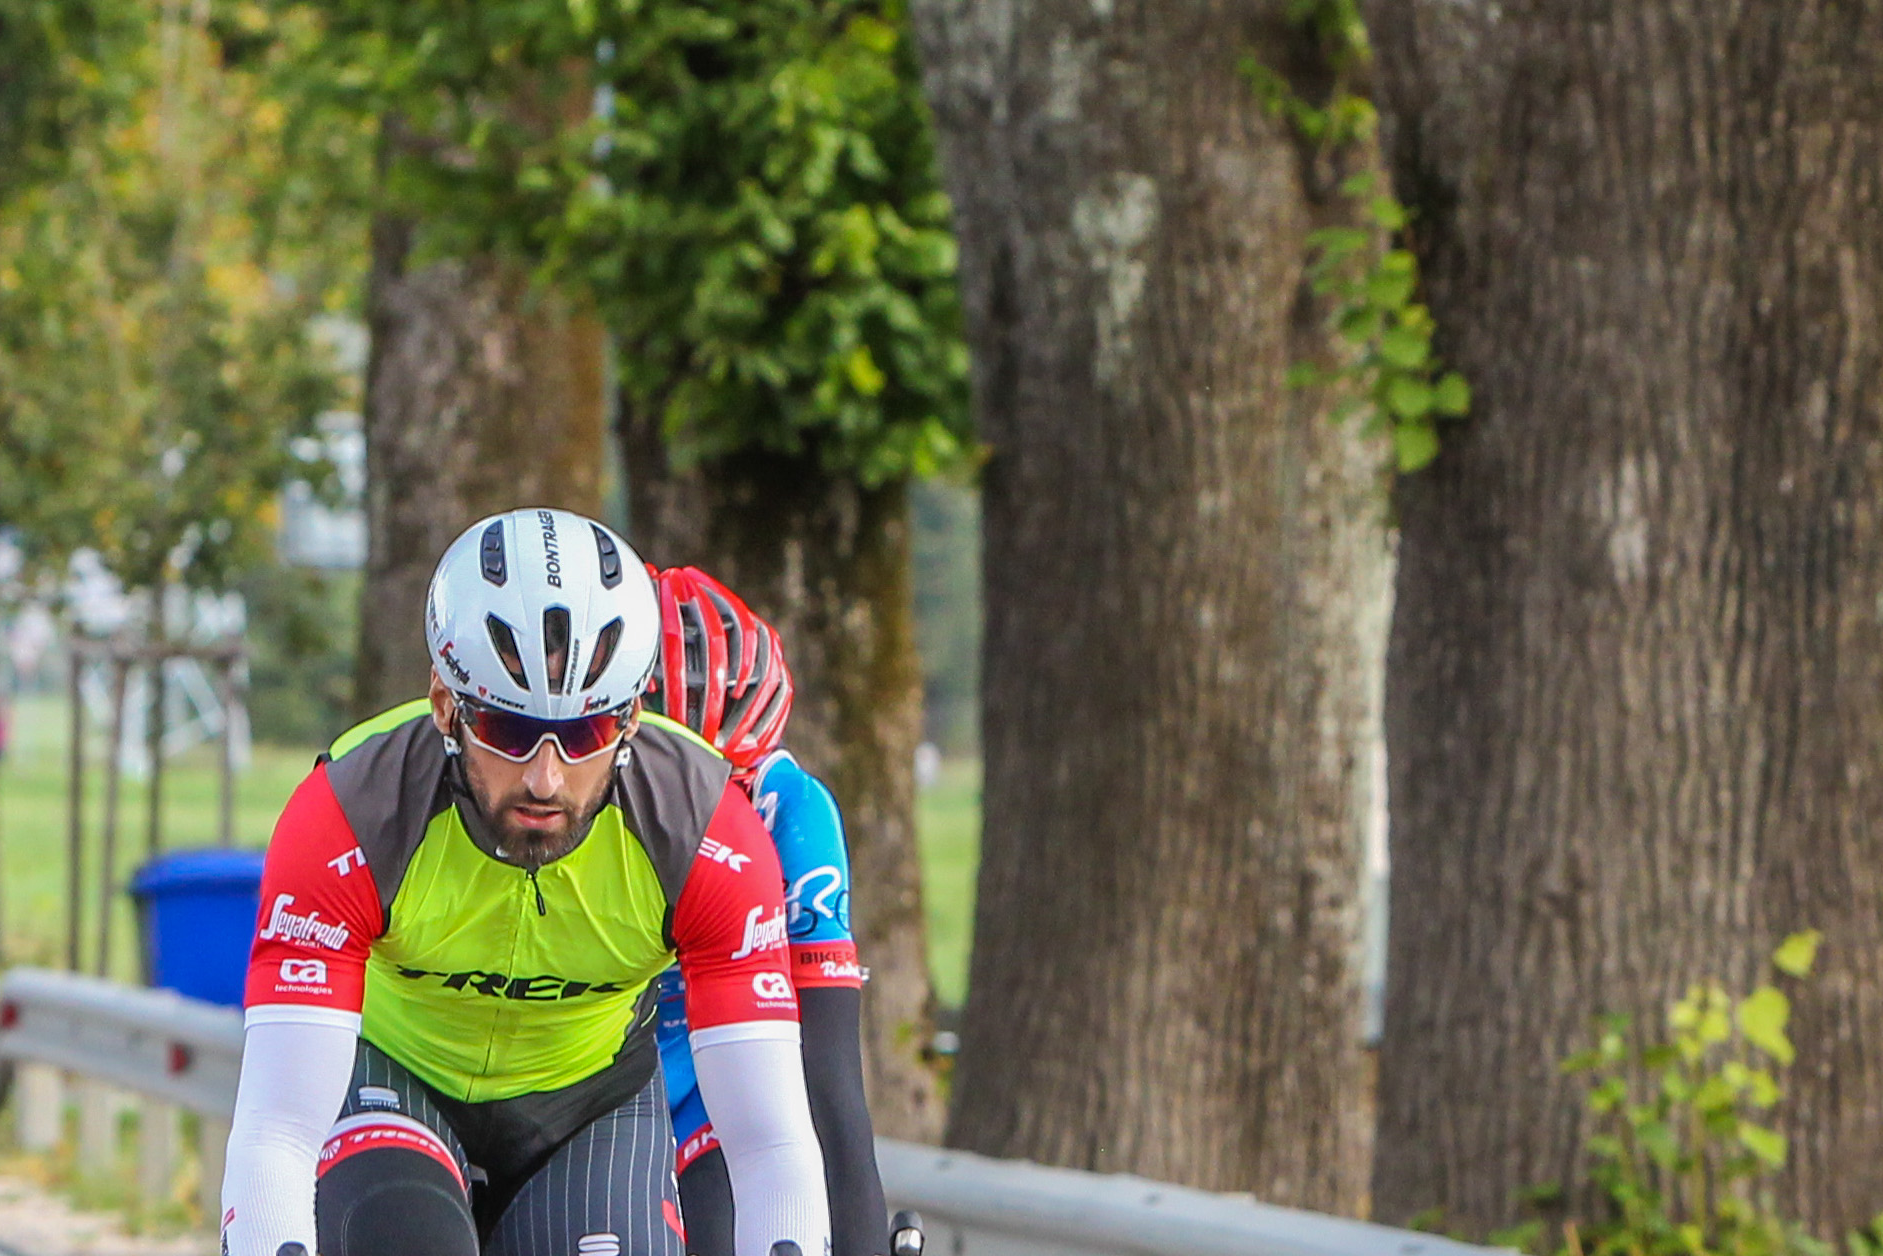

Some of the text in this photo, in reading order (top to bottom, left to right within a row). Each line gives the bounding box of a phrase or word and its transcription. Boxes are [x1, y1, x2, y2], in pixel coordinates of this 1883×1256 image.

[260, 893, 350, 950] Segafredo
[280, 958, 327, 984] ca
[396, 964, 632, 1000] TREK
[274, 984, 333, 995] technologies
[752, 972, 792, 999] ca
[349, 1129, 441, 1154] TREK
